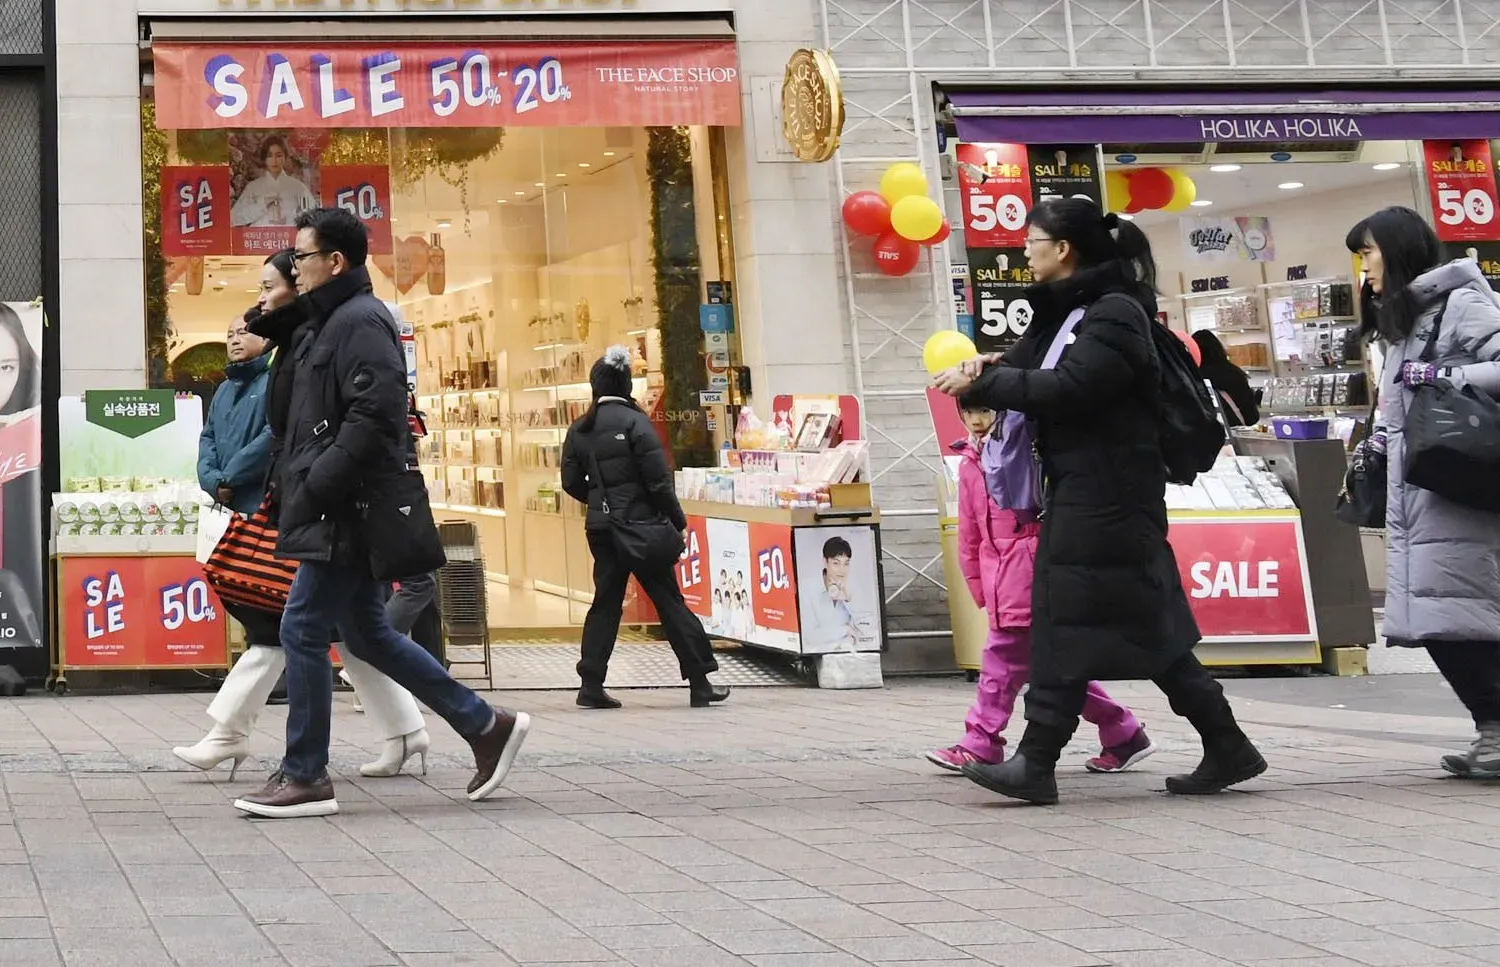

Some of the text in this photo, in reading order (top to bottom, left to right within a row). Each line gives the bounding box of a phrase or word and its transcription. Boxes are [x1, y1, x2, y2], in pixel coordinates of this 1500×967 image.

[596, 67, 737, 82] THE FACE SHOP
[205, 54, 403, 118] SALE
[1201, 118, 1362, 138] HOLIKA HOLIKA
[103, 403, 160, 417] 실속상품전
[666, 411, 699, 422] SHOP
[1191, 560, 1279, 598] SALE
[162, 579, 215, 630] 50%
